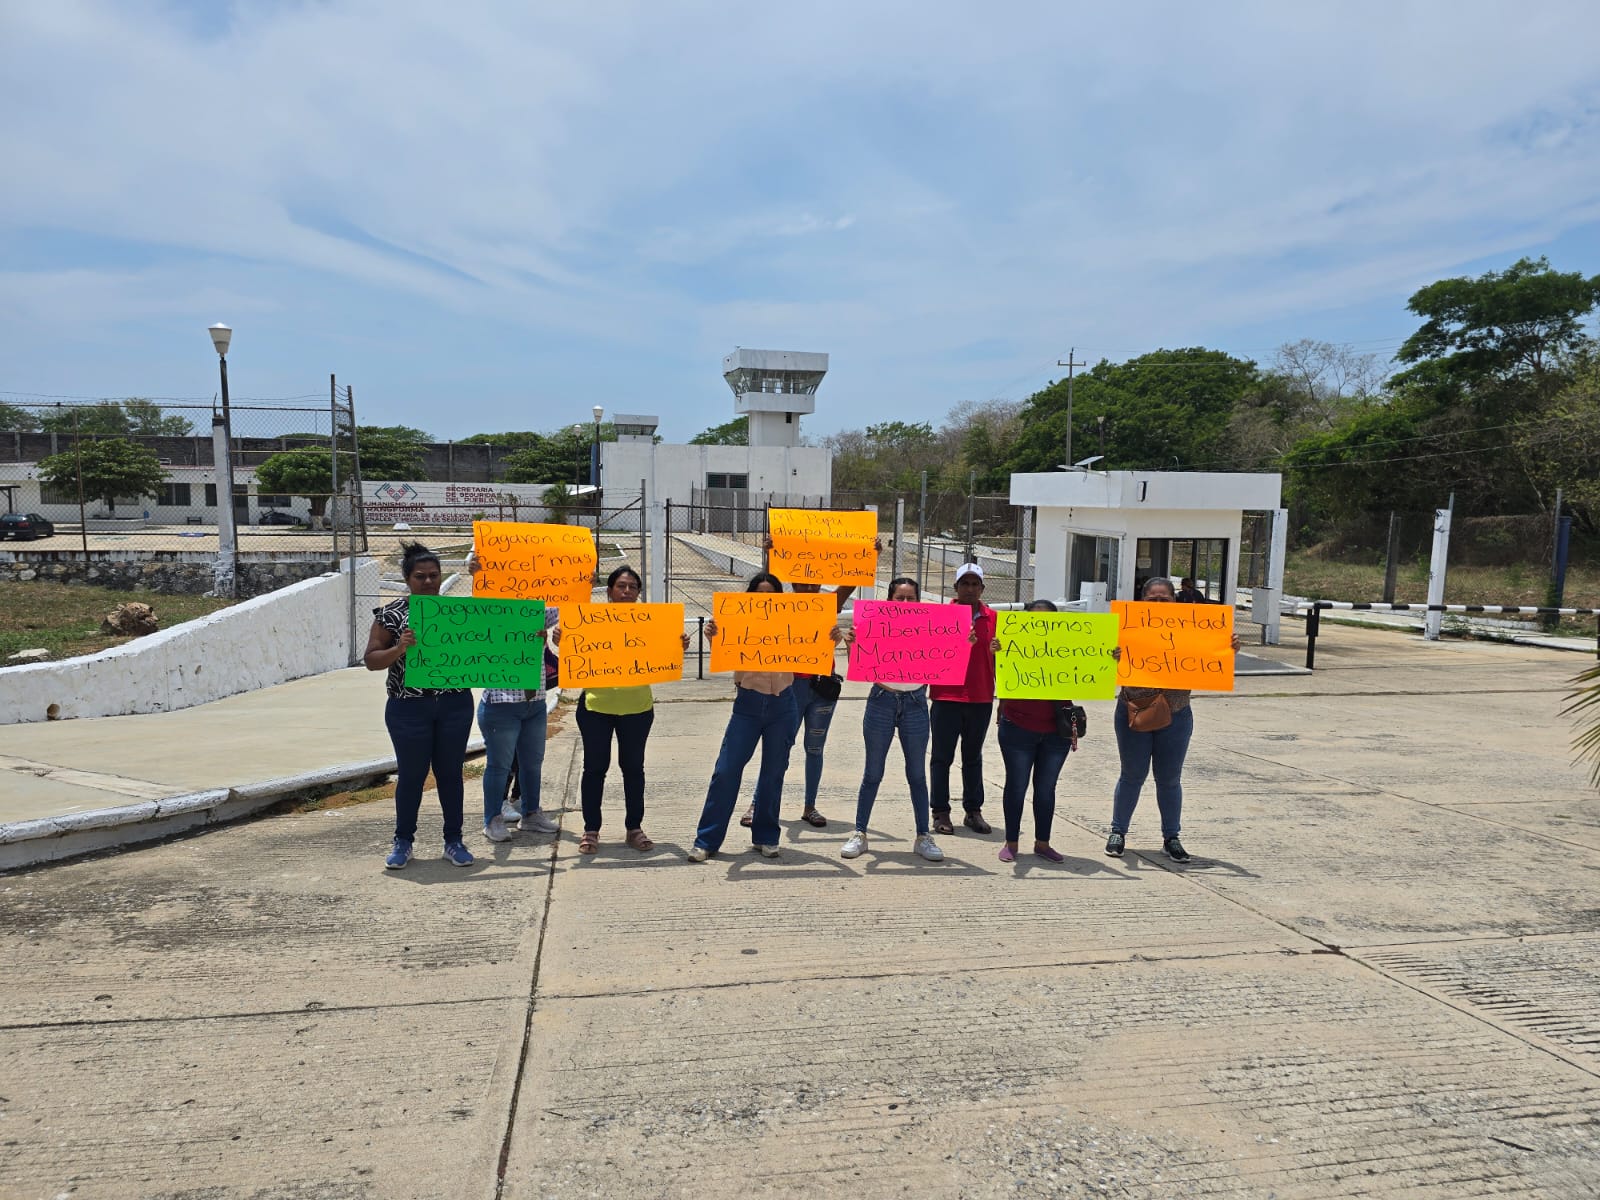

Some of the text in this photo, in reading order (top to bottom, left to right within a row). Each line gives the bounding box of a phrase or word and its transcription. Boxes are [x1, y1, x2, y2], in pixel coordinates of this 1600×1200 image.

[476, 523, 592, 552] Pagaron con
[773, 547, 873, 561] No es uno de
[475, 570, 591, 593] de 20 años de
[788, 562, 824, 579] Ellos
[415, 597, 514, 634] Pagaron
[563, 604, 652, 630] Justicia
[719, 596, 824, 621] Exigimos
[861, 600, 930, 619] Exigimos
[1122, 603, 1227, 630] Libertad
[720, 623, 819, 647] Libertad
[865, 619, 962, 639] Libertad
[1002, 613, 1093, 637] Exigimos
[504, 630, 538, 644] ma
[565, 632, 647, 654] Para los
[408, 648, 536, 669] de 20 años de
[1001, 639, 1114, 660] Audiencia
[1116, 645, 1224, 679] Justicia
[427, 669, 521, 688] Servicio
